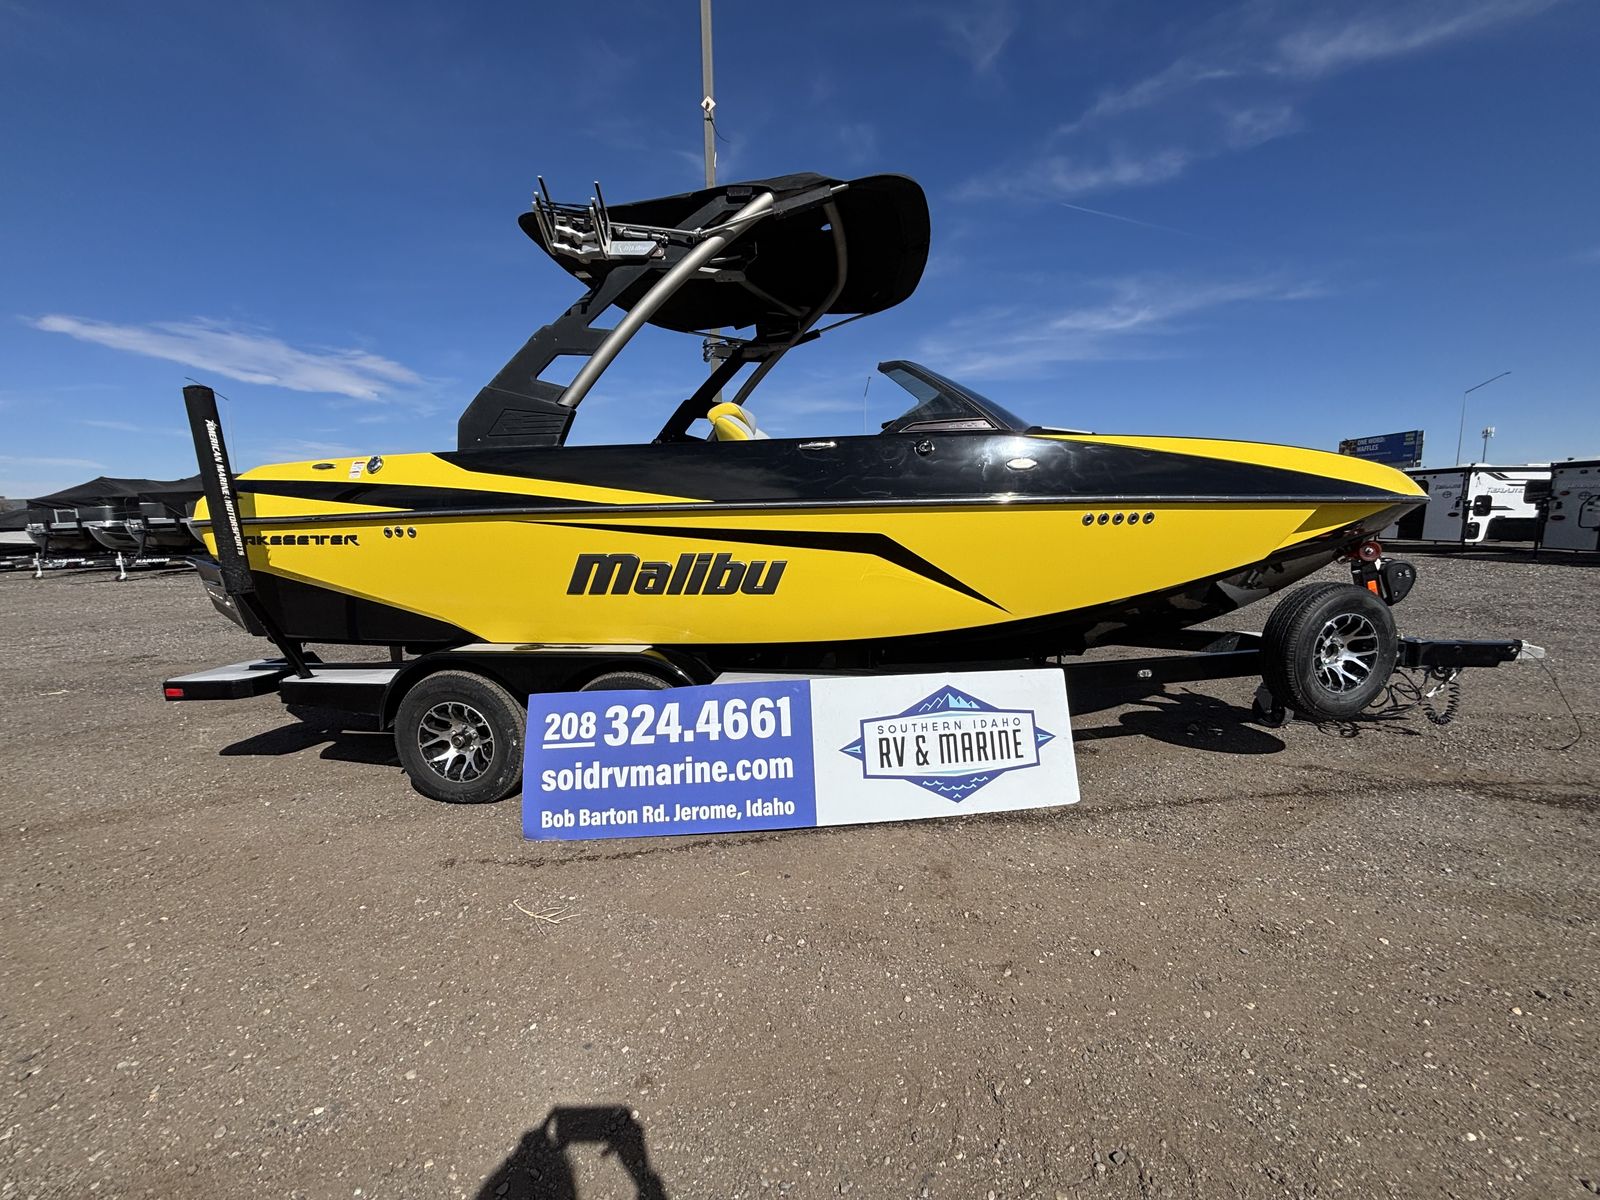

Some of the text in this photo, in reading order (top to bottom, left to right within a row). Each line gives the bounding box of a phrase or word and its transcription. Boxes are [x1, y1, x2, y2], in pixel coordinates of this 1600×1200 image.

[205, 419, 223, 463] AMERICAN
[216, 464, 230, 495] MARINE
[224, 500, 245, 556] MOTORSPORTS
[243, 535, 360, 546] AKESETTER
[566, 552, 788, 595] Malibu
[542, 696, 792, 747] 208 324.4661
[877, 717, 1021, 734] SOUTHERN IDAHO
[878, 729, 1024, 769] RV & MARINE
[541, 756, 794, 792] soidrvmarine.com
[541, 797, 795, 828] Bob Barton Rd. Jerome, Idaho
